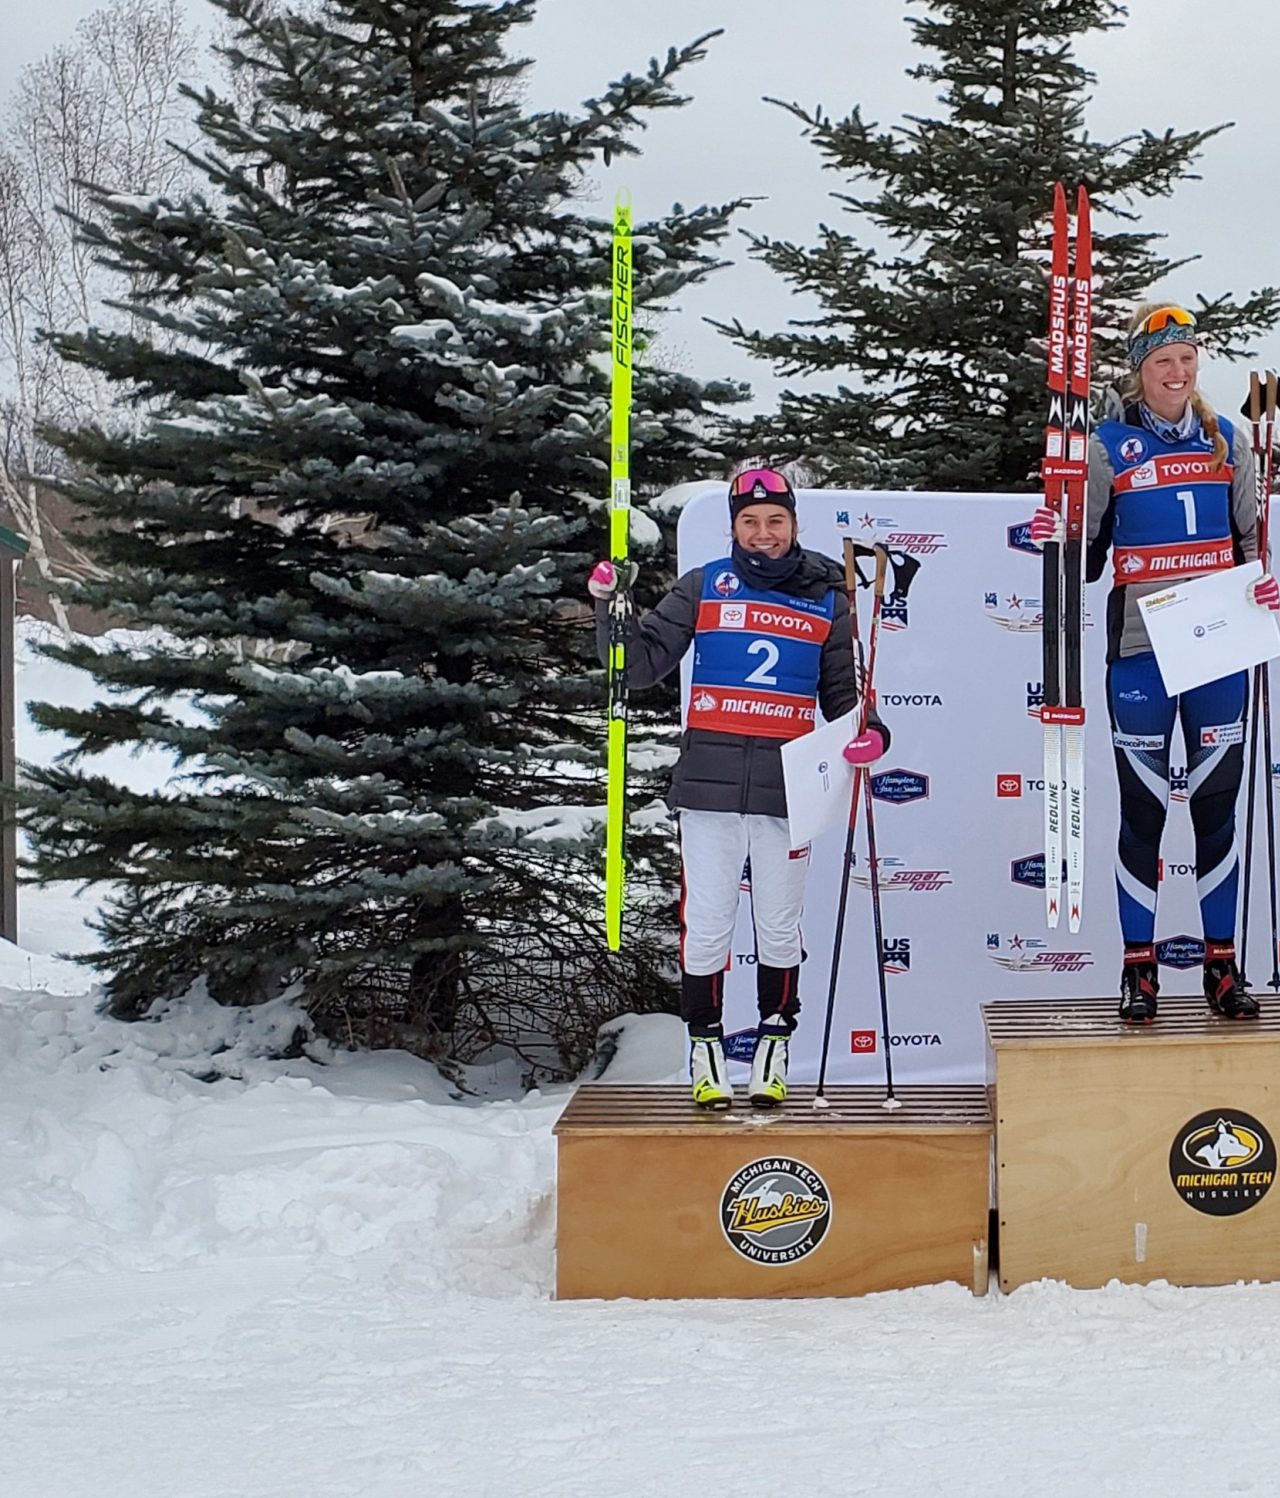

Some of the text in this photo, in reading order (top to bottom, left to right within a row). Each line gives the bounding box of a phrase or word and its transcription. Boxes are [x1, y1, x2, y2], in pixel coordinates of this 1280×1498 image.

[616, 245, 629, 368] FISCHER
[1051, 274, 1066, 374] MADSHUS
[1073, 278, 1089, 378] MADSHUS
[1161, 461, 1210, 477] TOYOT
[1176, 491, 1197, 535] 1
[1149, 552, 1218, 571] MICHIGAN
[751, 610, 814, 633] TOYOTA
[744, 639, 780, 686] 2
[721, 698, 793, 719] MICHIGAN
[882, 695, 943, 706] TOYOTA
[1049, 782, 1059, 834] REDLINE
[1071, 787, 1081, 839] REDLINE
[884, 938, 911, 951] US
[730, 1160, 822, 1193] MICHIGAN TECH
[1176, 1171, 1273, 1187] MICHIGAN TECH
[1186, 1189, 1262, 1199] HUSKIES
[732, 1195, 825, 1228] Huskies
[739, 1237, 815, 1262] UNIVERSITY
